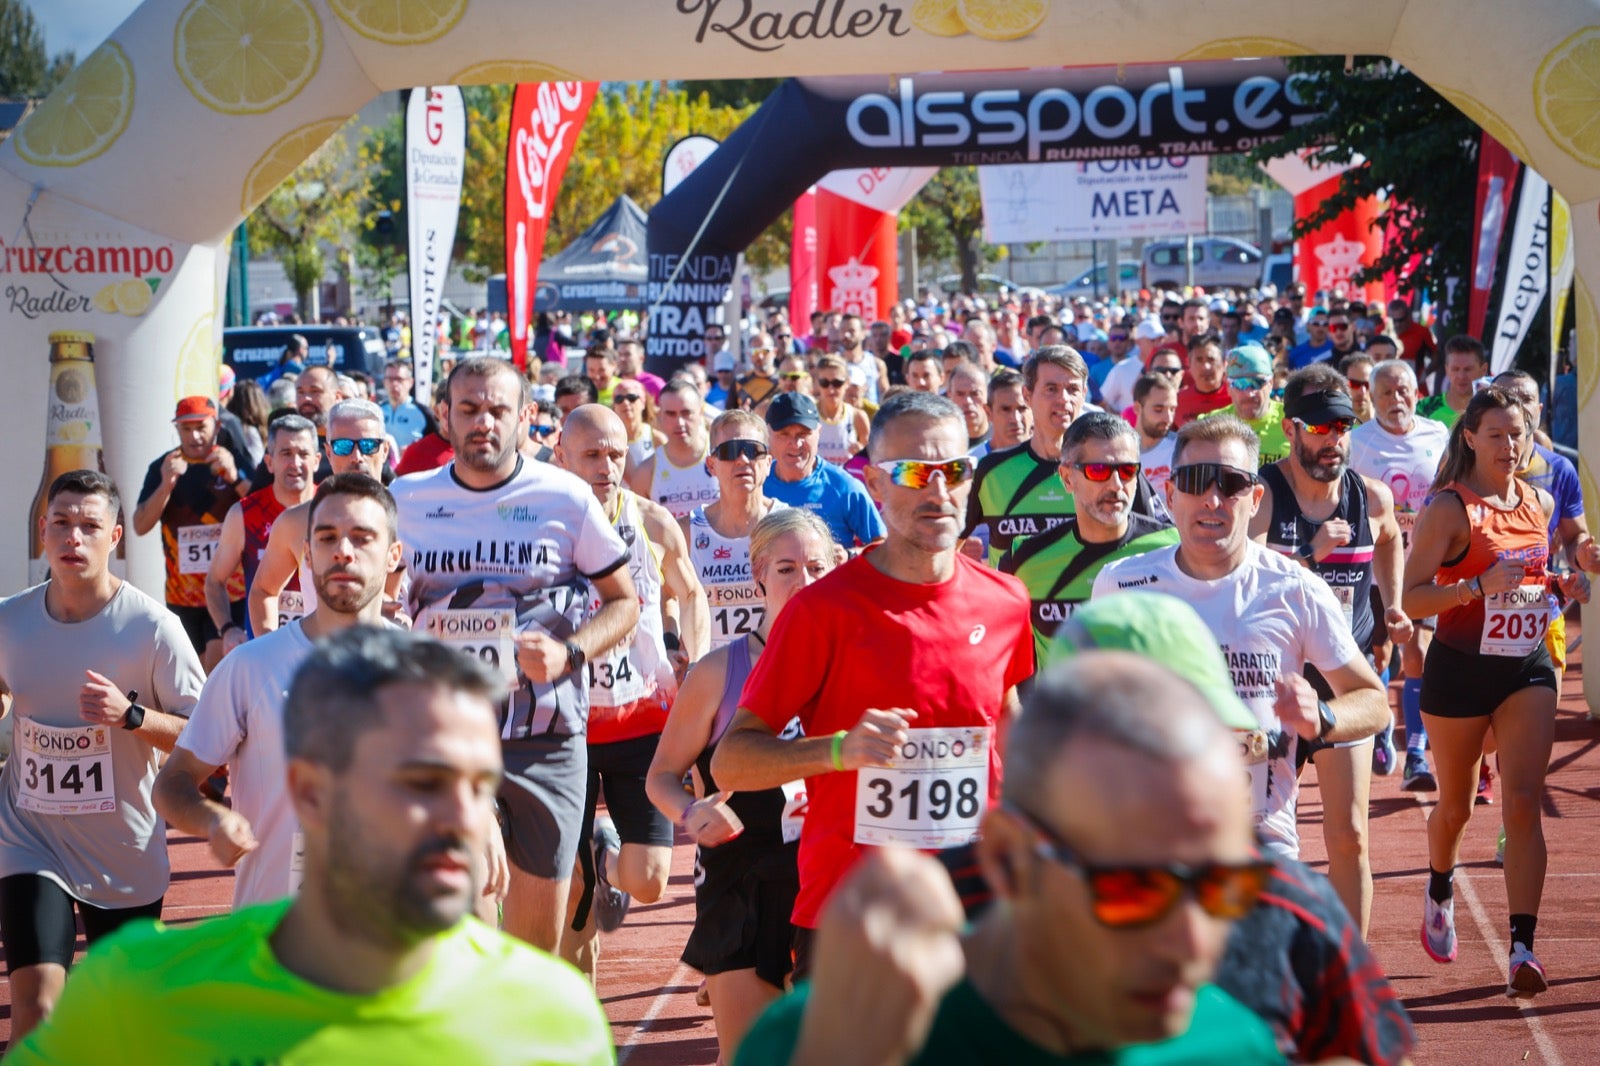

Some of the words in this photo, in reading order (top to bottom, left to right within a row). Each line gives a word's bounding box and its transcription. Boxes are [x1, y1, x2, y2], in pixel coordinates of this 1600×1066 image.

[675, 0, 910, 52] Radler
[845, 66, 1338, 161] alssport.es
[952, 150, 1024, 164] TIENDA
[1045, 146, 1142, 161] RUNNING
[1159, 140, 1215, 155] TRAIL
[1091, 188, 1180, 218] META
[0, 235, 174, 278] ruzcampo
[649, 254, 733, 280] TIENDA
[5, 282, 93, 320] Radler
[997, 517, 1040, 535] CAJA
[412, 540, 549, 574] PURULLENA
[702, 562, 753, 578] MARAC
[1117, 575, 1147, 589] luanvi
[1503, 591, 1541, 604] FONDO
[440, 617, 497, 633] FONDO
[1487, 612, 1548, 640] 2031
[1230, 669, 1277, 687] RANADA
[32, 731, 90, 751] FONDO
[901, 739, 966, 760] ONDO
[25, 757, 103, 795] 3141
[866, 777, 979, 821] 3198
